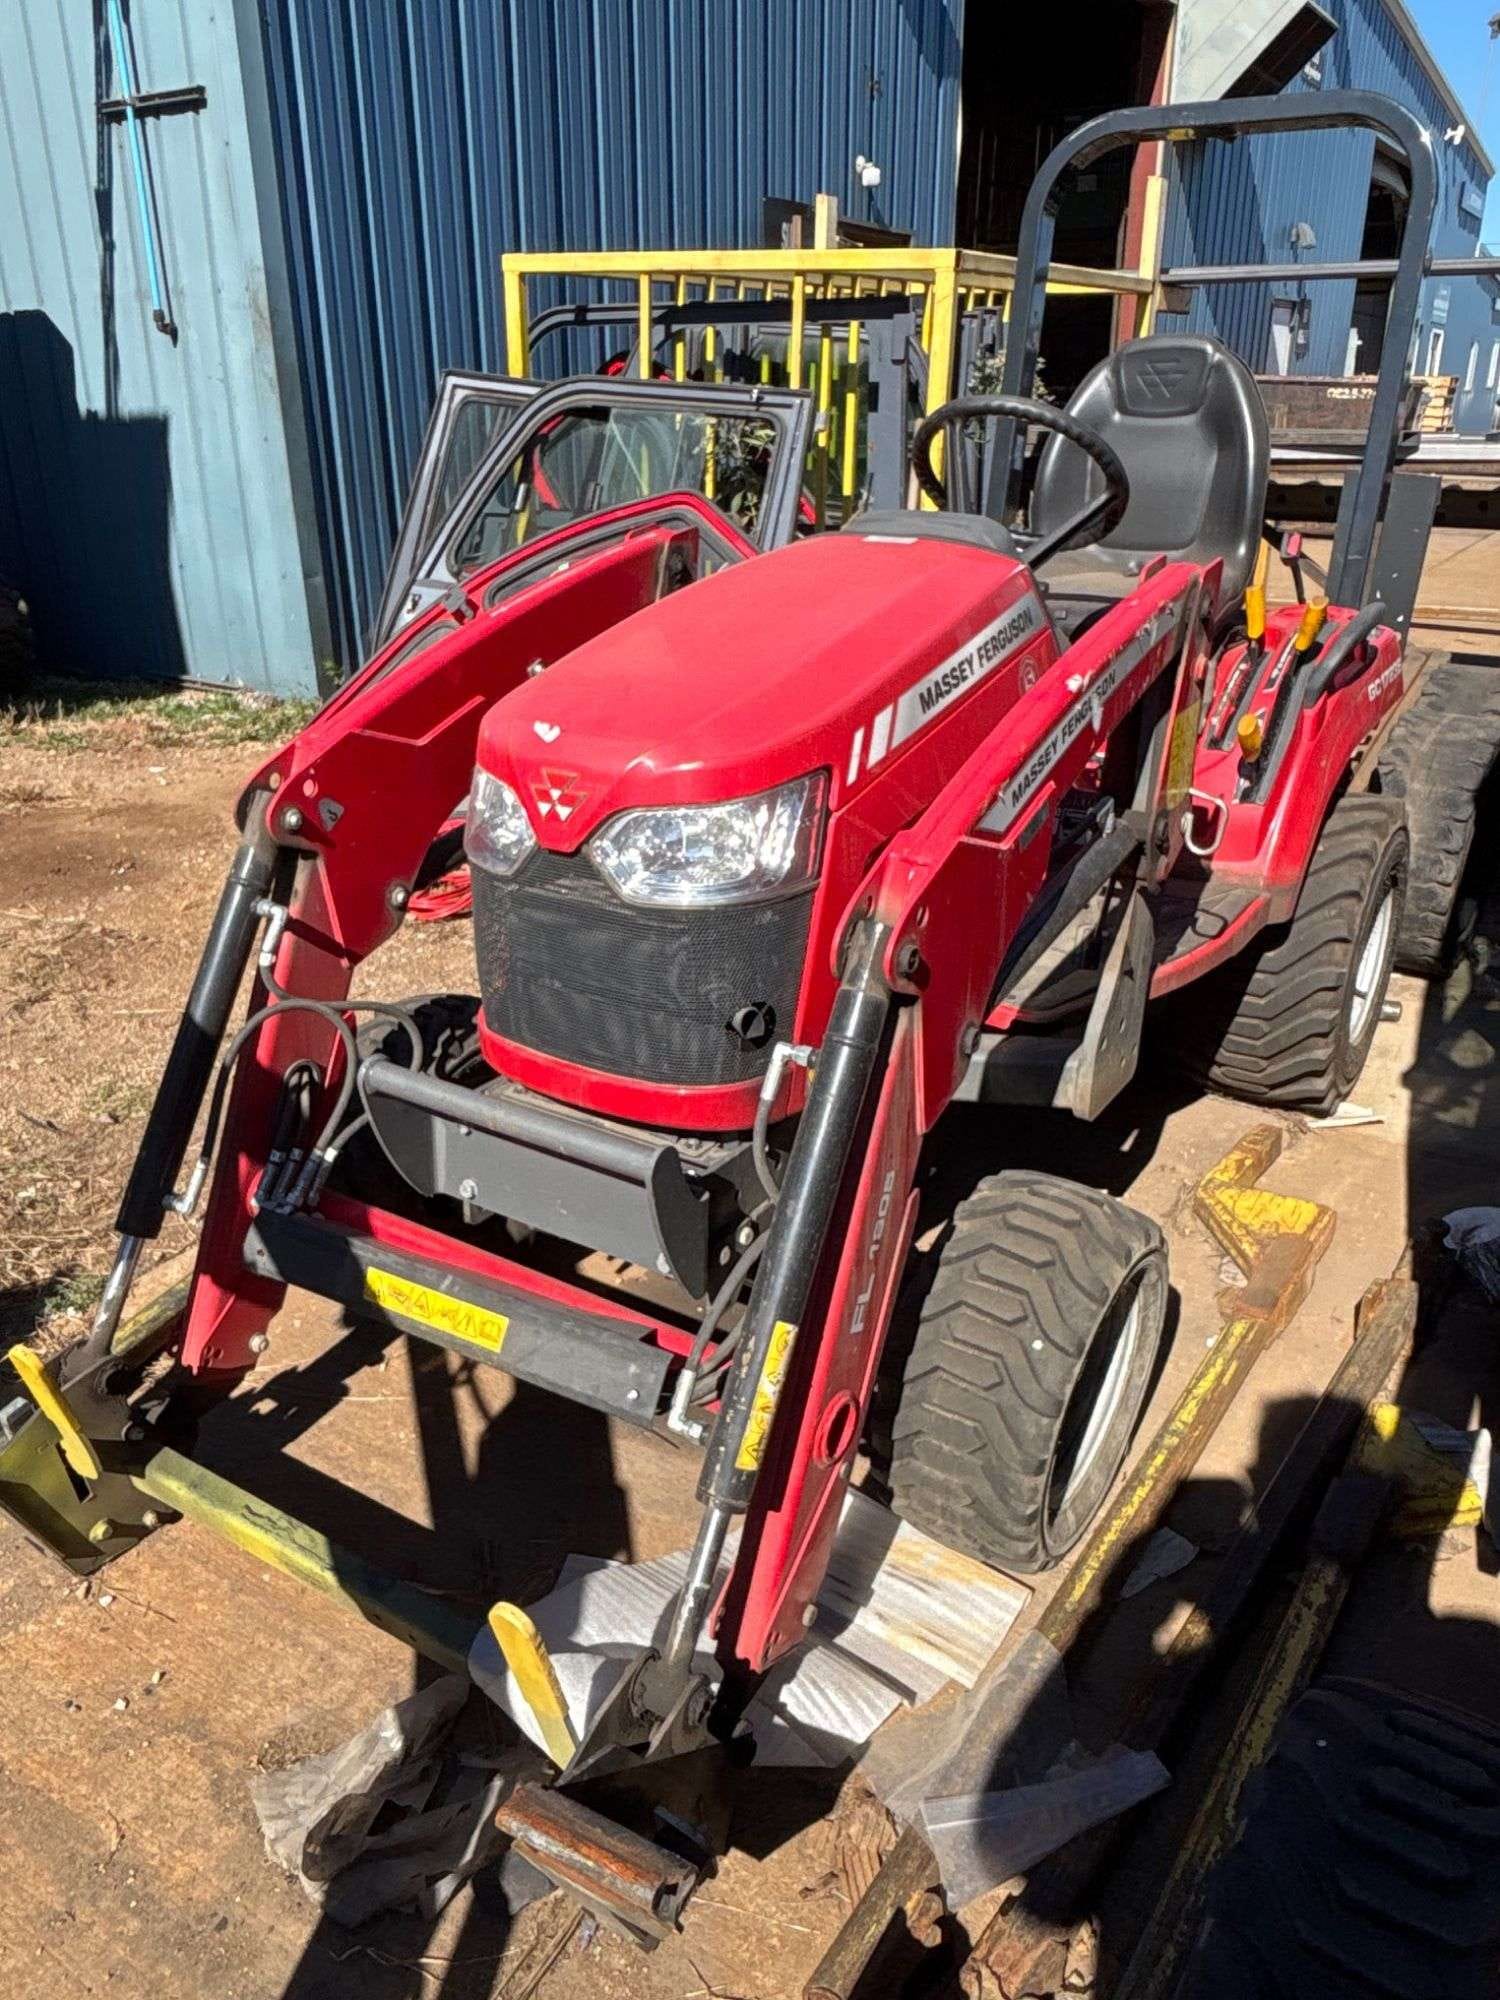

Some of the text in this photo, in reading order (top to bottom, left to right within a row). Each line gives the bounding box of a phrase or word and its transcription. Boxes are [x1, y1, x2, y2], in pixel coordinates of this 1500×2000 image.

[918, 607, 1034, 715] MASSEY FERGUSON
[1011, 738, 1059, 807] MASSEY
[850, 1273, 875, 1334] FL
